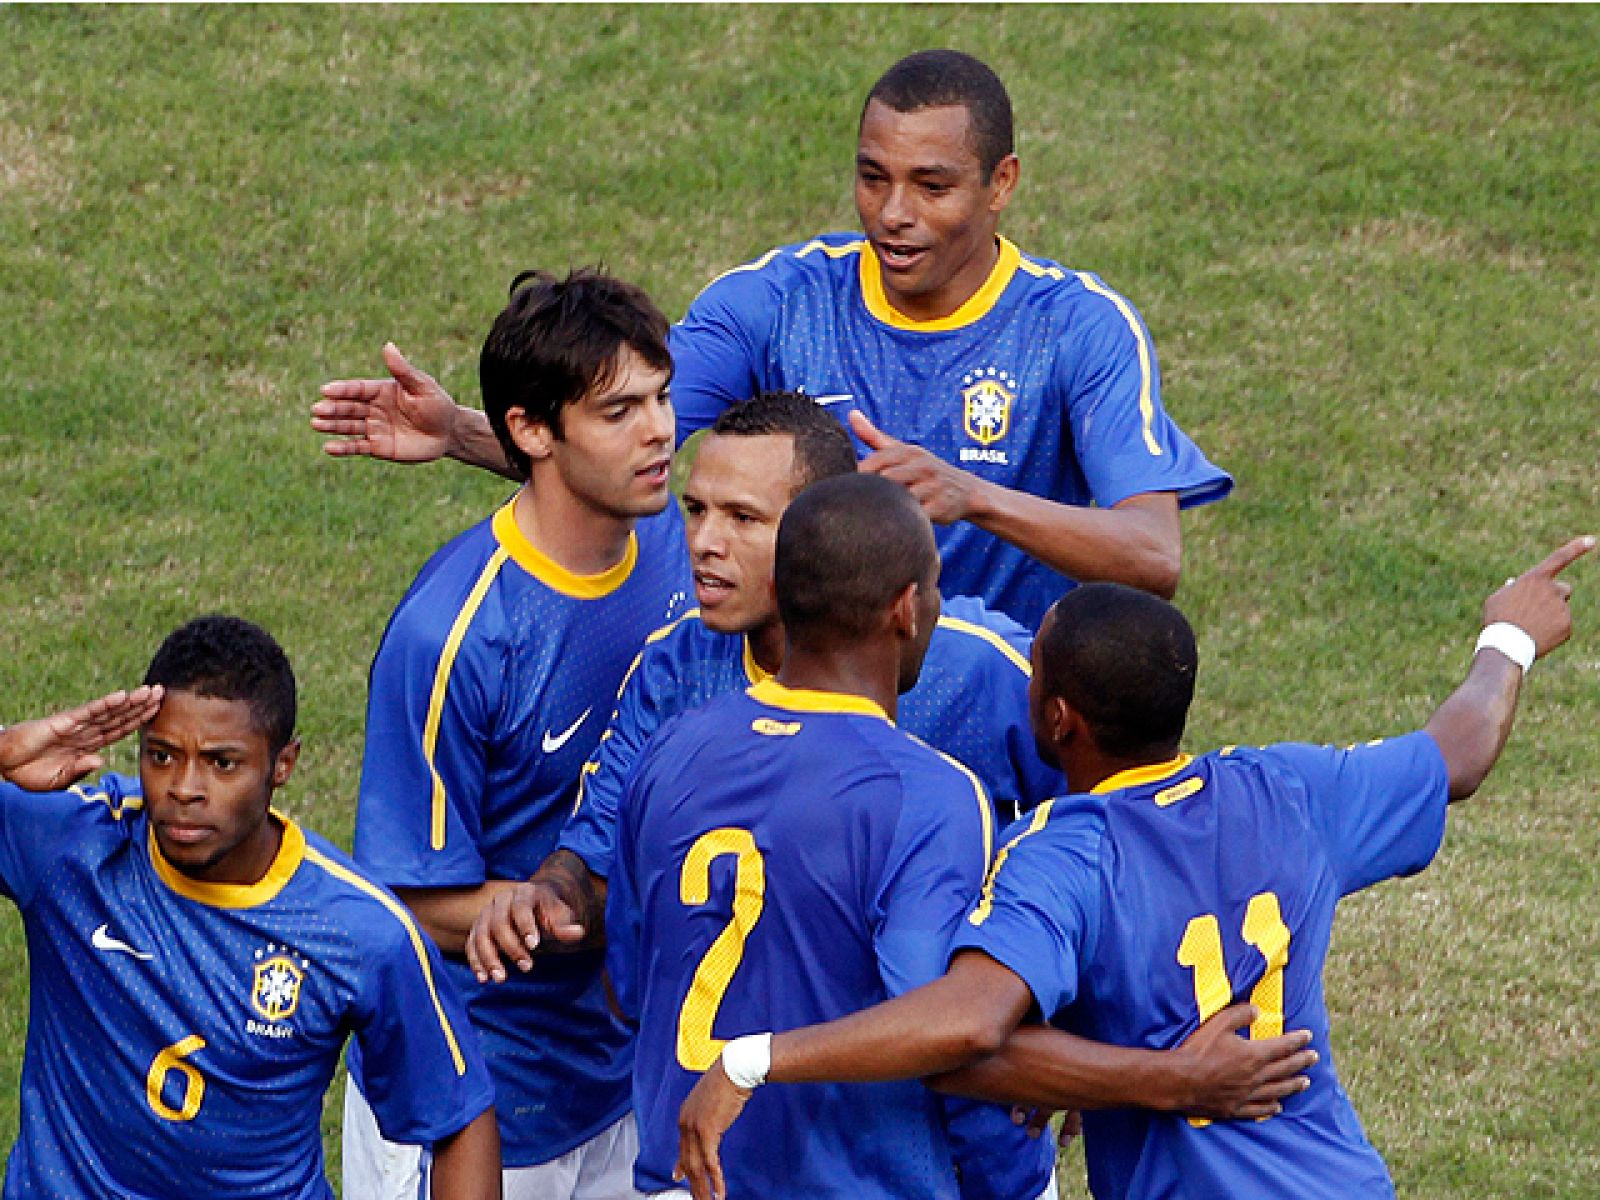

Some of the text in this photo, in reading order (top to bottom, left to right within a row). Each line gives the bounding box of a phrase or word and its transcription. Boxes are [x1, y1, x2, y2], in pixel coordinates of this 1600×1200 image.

[959, 447, 1008, 465] BRASIL
[677, 828, 765, 1071] 2
[1177, 892, 1291, 1126] 11
[147, 1034, 206, 1121] 6
